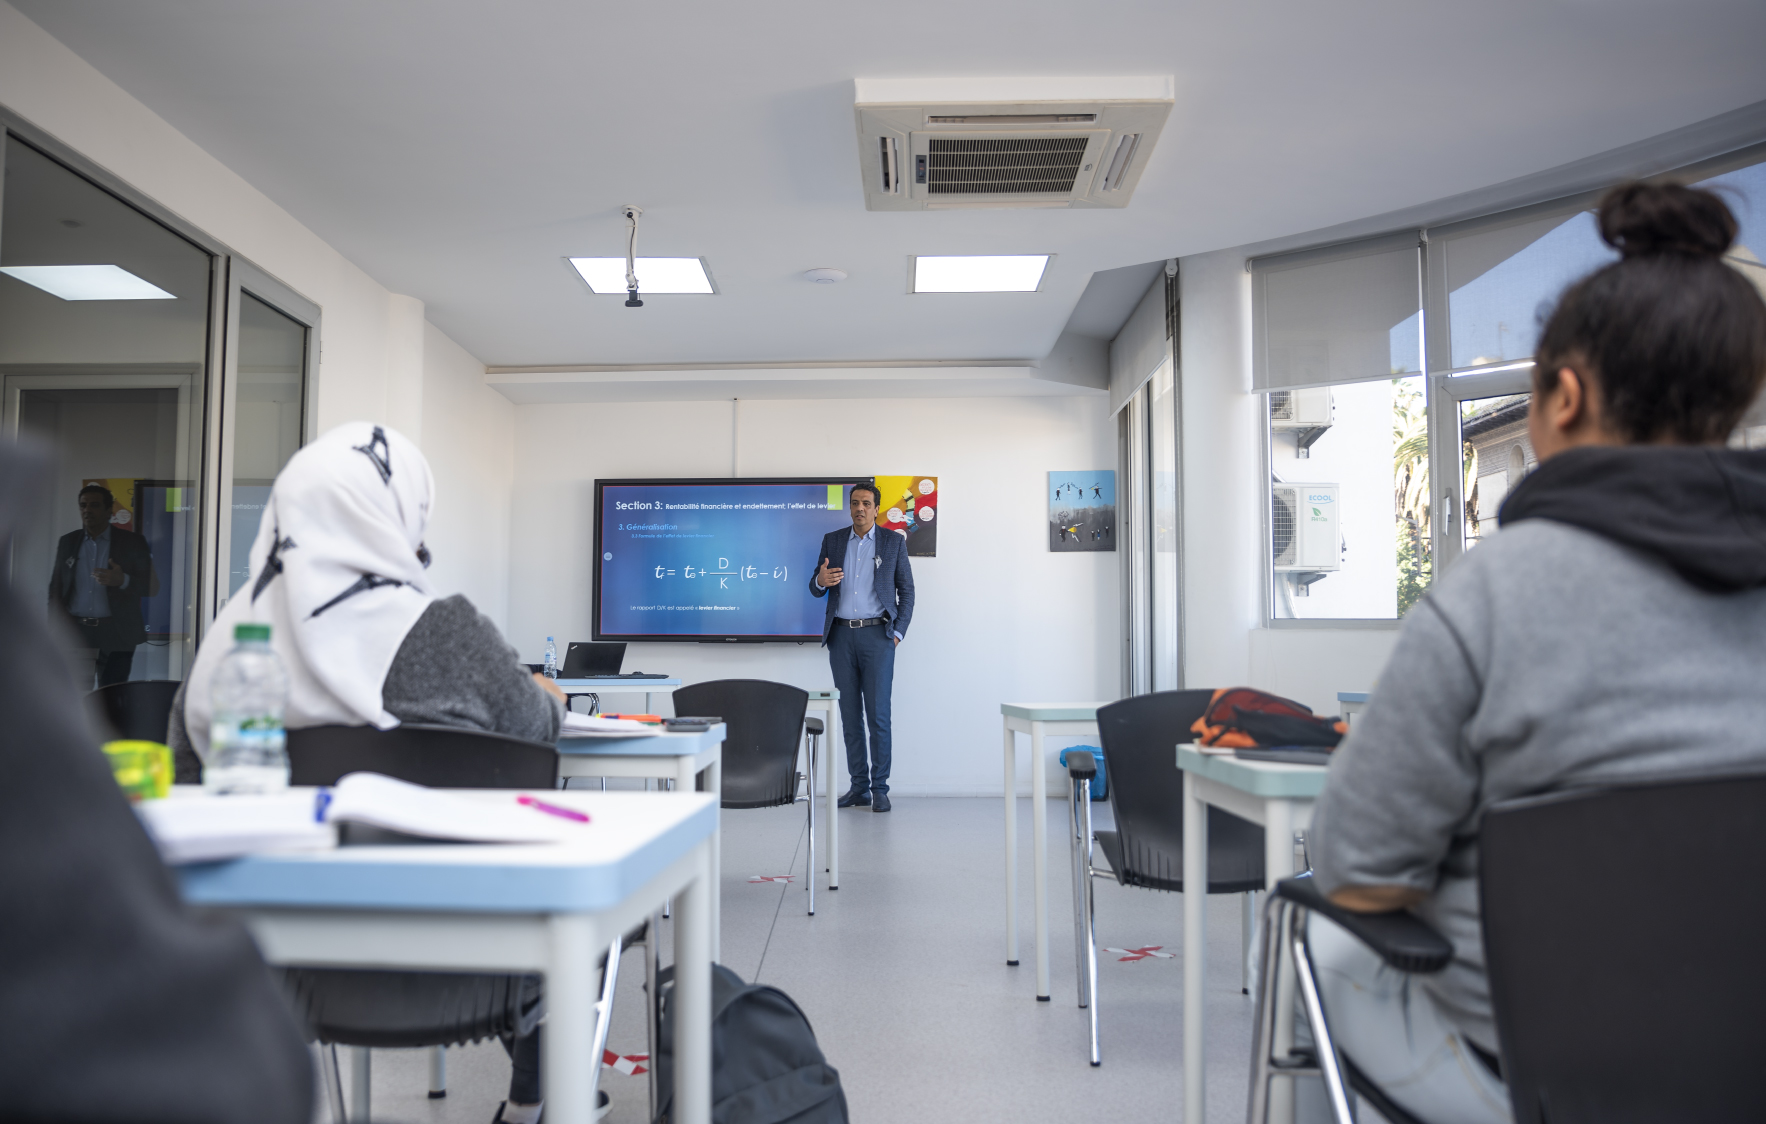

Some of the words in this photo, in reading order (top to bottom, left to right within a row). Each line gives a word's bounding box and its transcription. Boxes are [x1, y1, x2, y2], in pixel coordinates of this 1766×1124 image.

[615, 501, 652, 510] Section
[654, 501, 663, 510] 3:
[618, 523, 625, 531] 3.
[626, 523, 678, 531] Généralisation
[718, 557, 729, 570] D
[720, 577, 729, 590] K
